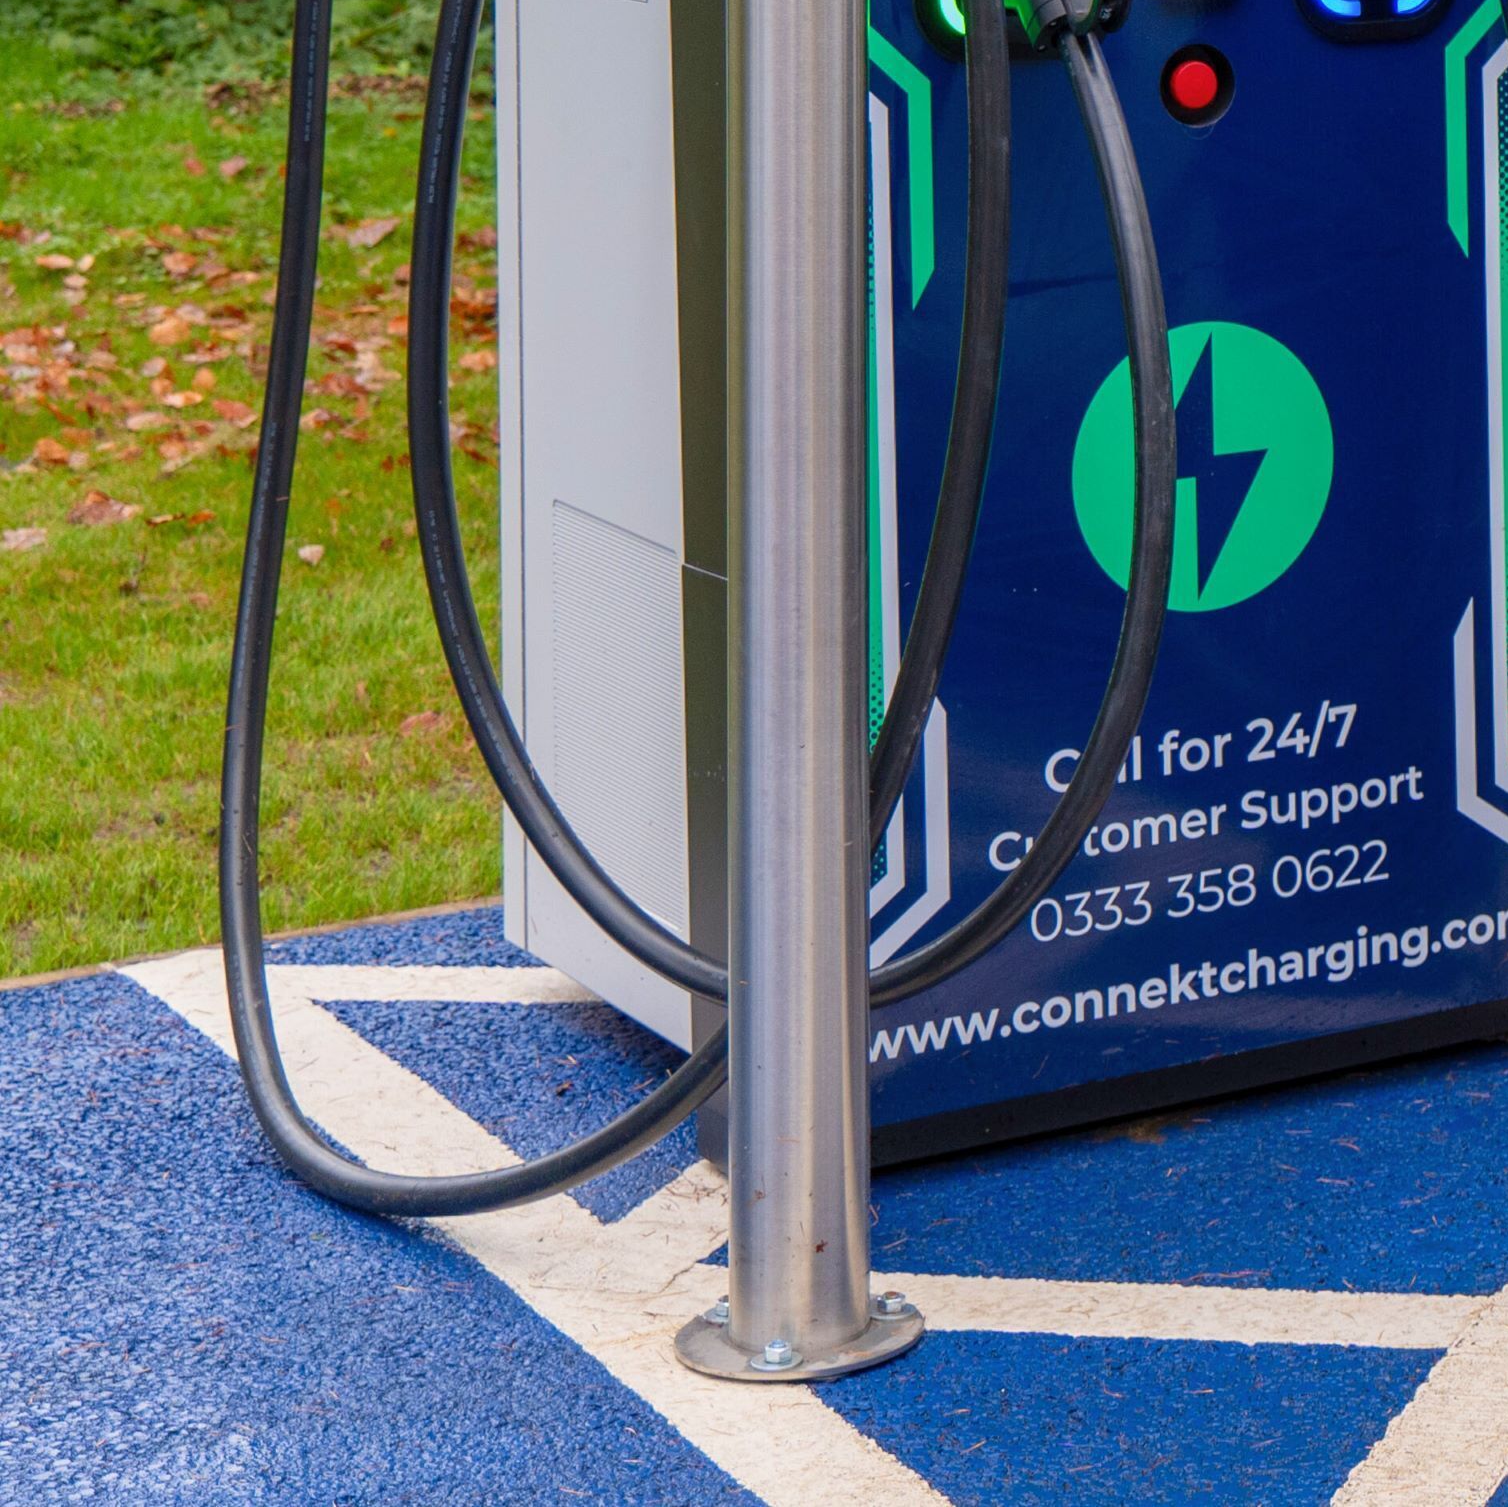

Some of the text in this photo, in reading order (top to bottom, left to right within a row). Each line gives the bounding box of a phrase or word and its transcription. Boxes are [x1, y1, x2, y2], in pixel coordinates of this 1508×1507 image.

[1158, 729, 1231, 776] for
[1246, 699, 1357, 762] 24/7
[989, 766, 1424, 871] Ctomer Support
[1031, 839, 1389, 942] 0333 358 0622
